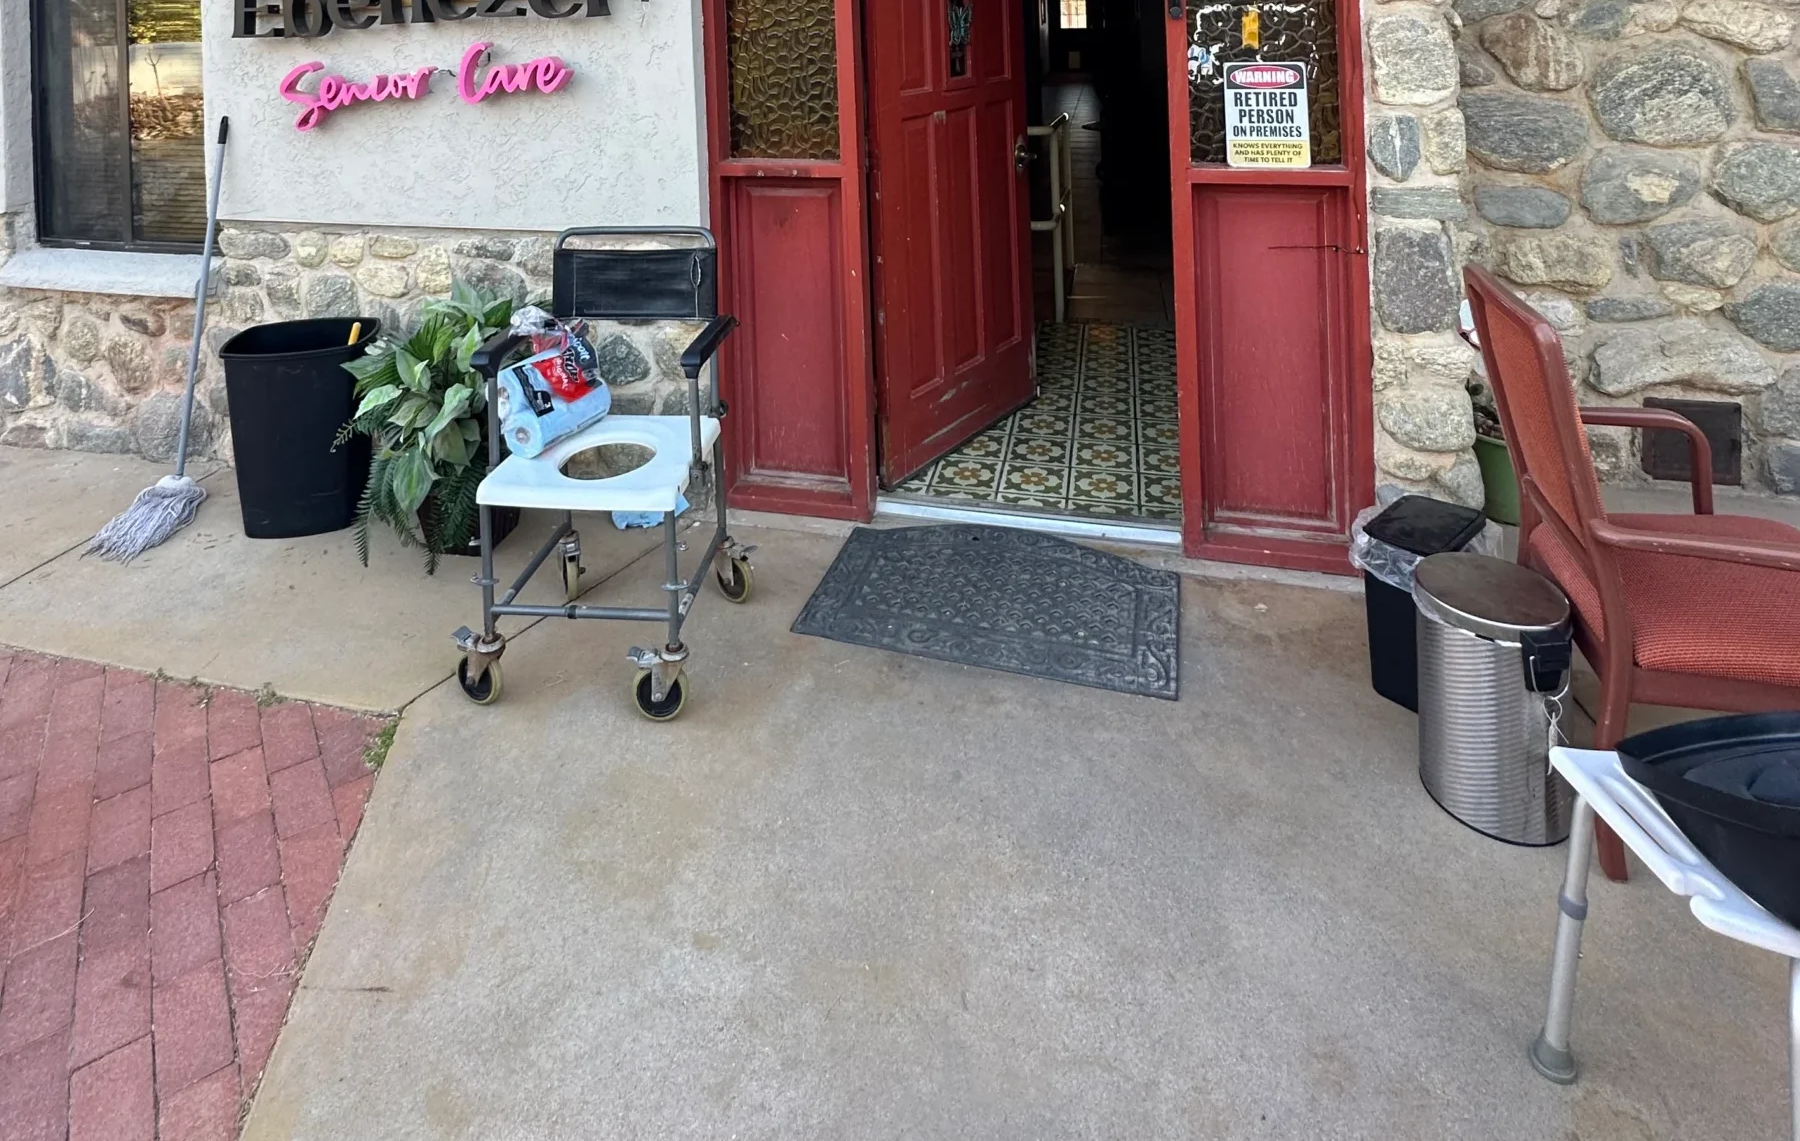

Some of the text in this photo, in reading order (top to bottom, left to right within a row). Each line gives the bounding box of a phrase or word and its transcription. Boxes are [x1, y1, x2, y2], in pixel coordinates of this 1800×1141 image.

[1234, 71, 1295, 83] WARNING
[280, 41, 574, 131] Senior Care
[1233, 91, 1298, 107] RETIRED
[1238, 109, 1295, 124] PERSON
[1233, 125, 1302, 138] ON PREMISES
